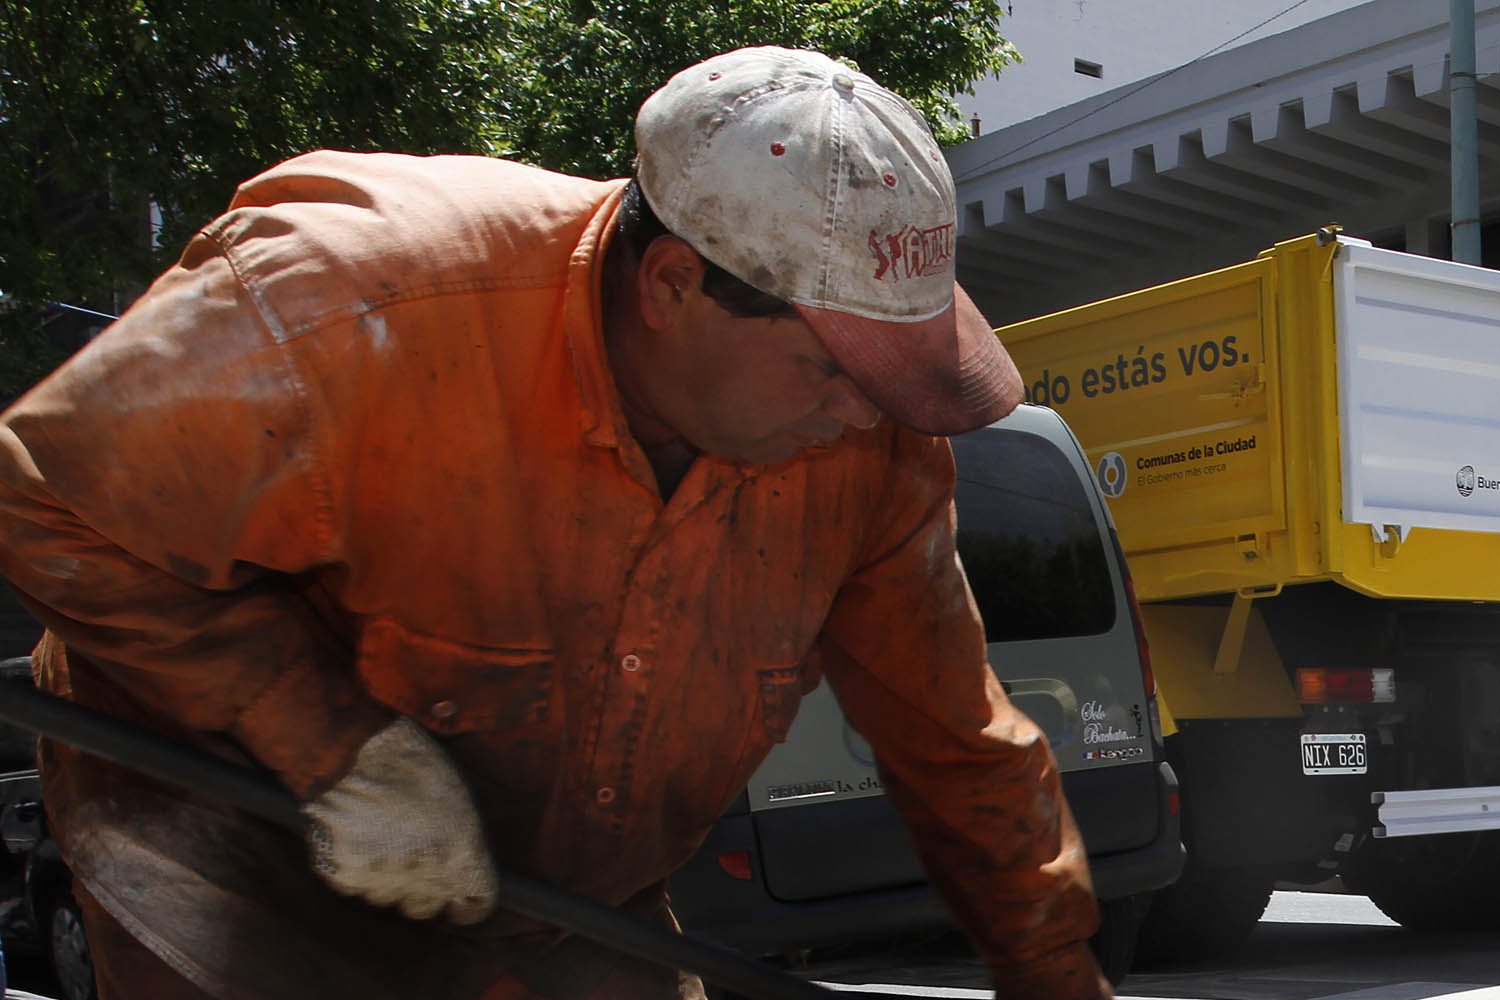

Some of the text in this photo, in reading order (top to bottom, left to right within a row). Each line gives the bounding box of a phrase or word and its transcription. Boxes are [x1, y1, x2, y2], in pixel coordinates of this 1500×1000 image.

[1081, 346, 1167, 398] estás
[1178, 335, 1249, 376] vos.
[1136, 435, 1256, 470] Comunas de la Ciudad
[1304, 744, 1364, 767] NIX 626
